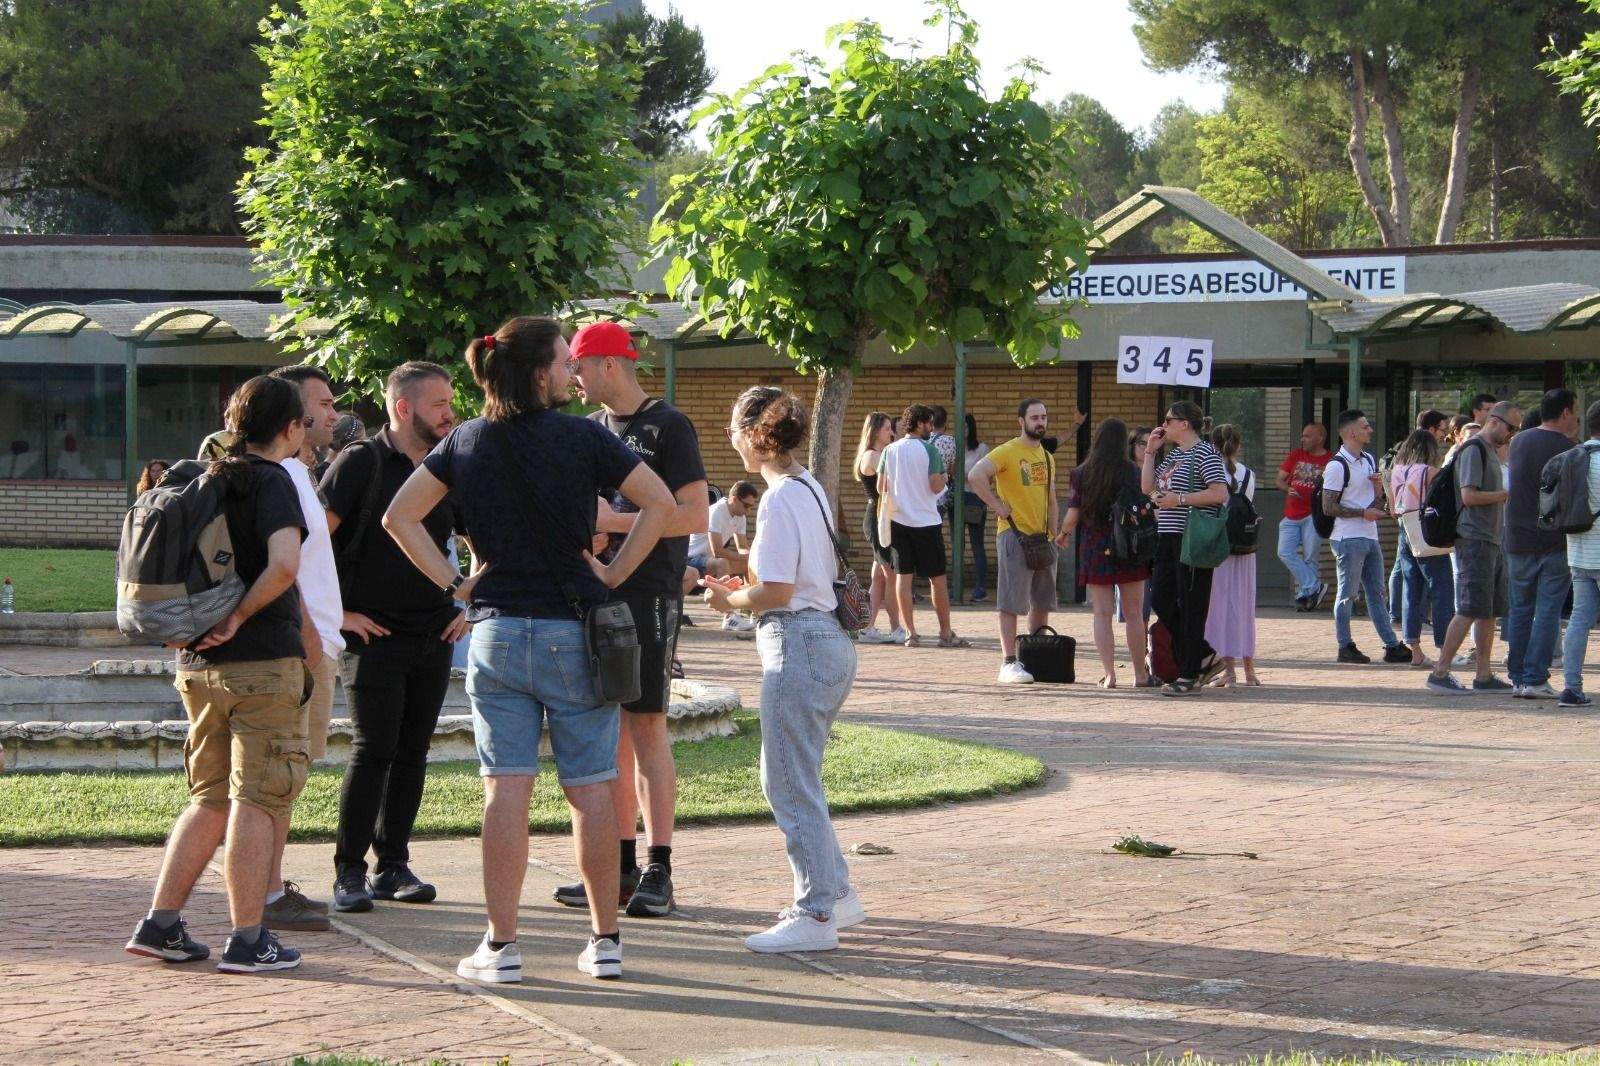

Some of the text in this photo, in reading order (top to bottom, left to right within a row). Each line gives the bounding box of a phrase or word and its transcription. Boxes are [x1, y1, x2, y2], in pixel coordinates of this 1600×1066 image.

[1123, 345, 1204, 376] 3 4 5
